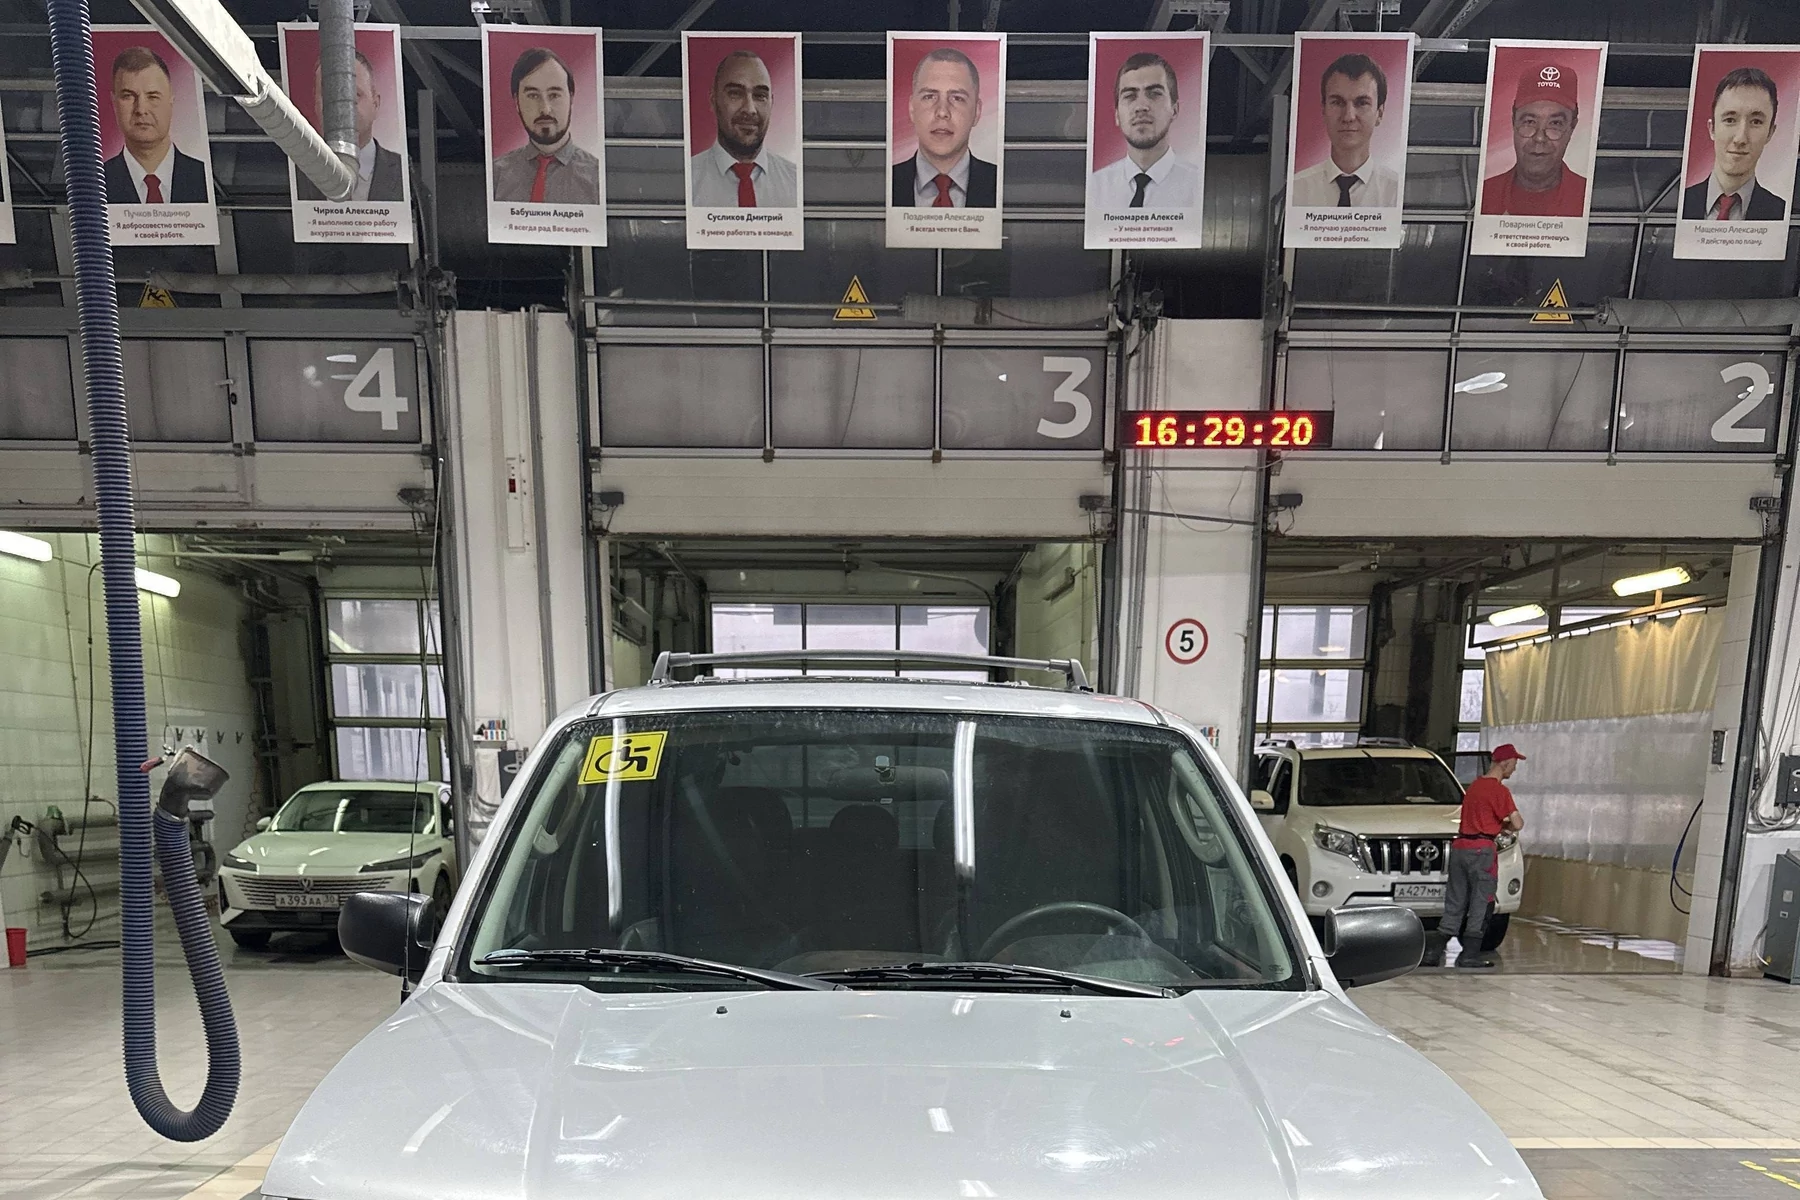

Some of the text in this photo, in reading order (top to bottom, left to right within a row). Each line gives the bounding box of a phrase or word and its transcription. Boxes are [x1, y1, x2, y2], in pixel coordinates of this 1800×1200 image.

[124, 210, 191, 219] Пучков Владимир
[313, 207, 390, 216] Чирков Александр
[510, 208, 584, 218] Бабушкин Андрей
[707, 213, 783, 222] Сусликов Дмитрий
[903, 213, 984, 222] Поздняков Александр
[1104, 214, 1149, 222] Пономарев
[1354, 213, 1382, 221] Сергей
[1537, 221, 1563, 230] Сергей
[726, 229, 757, 237] работать
[1728, 226, 1768, 235] Александр
[344, 348, 408, 430] 4
[1037, 356, 1092, 439] 3
[1711, 362, 1770, 442] 2
[1136, 417, 1313, 446] 16:29:20
[1180, 630, 1194, 652] 5
